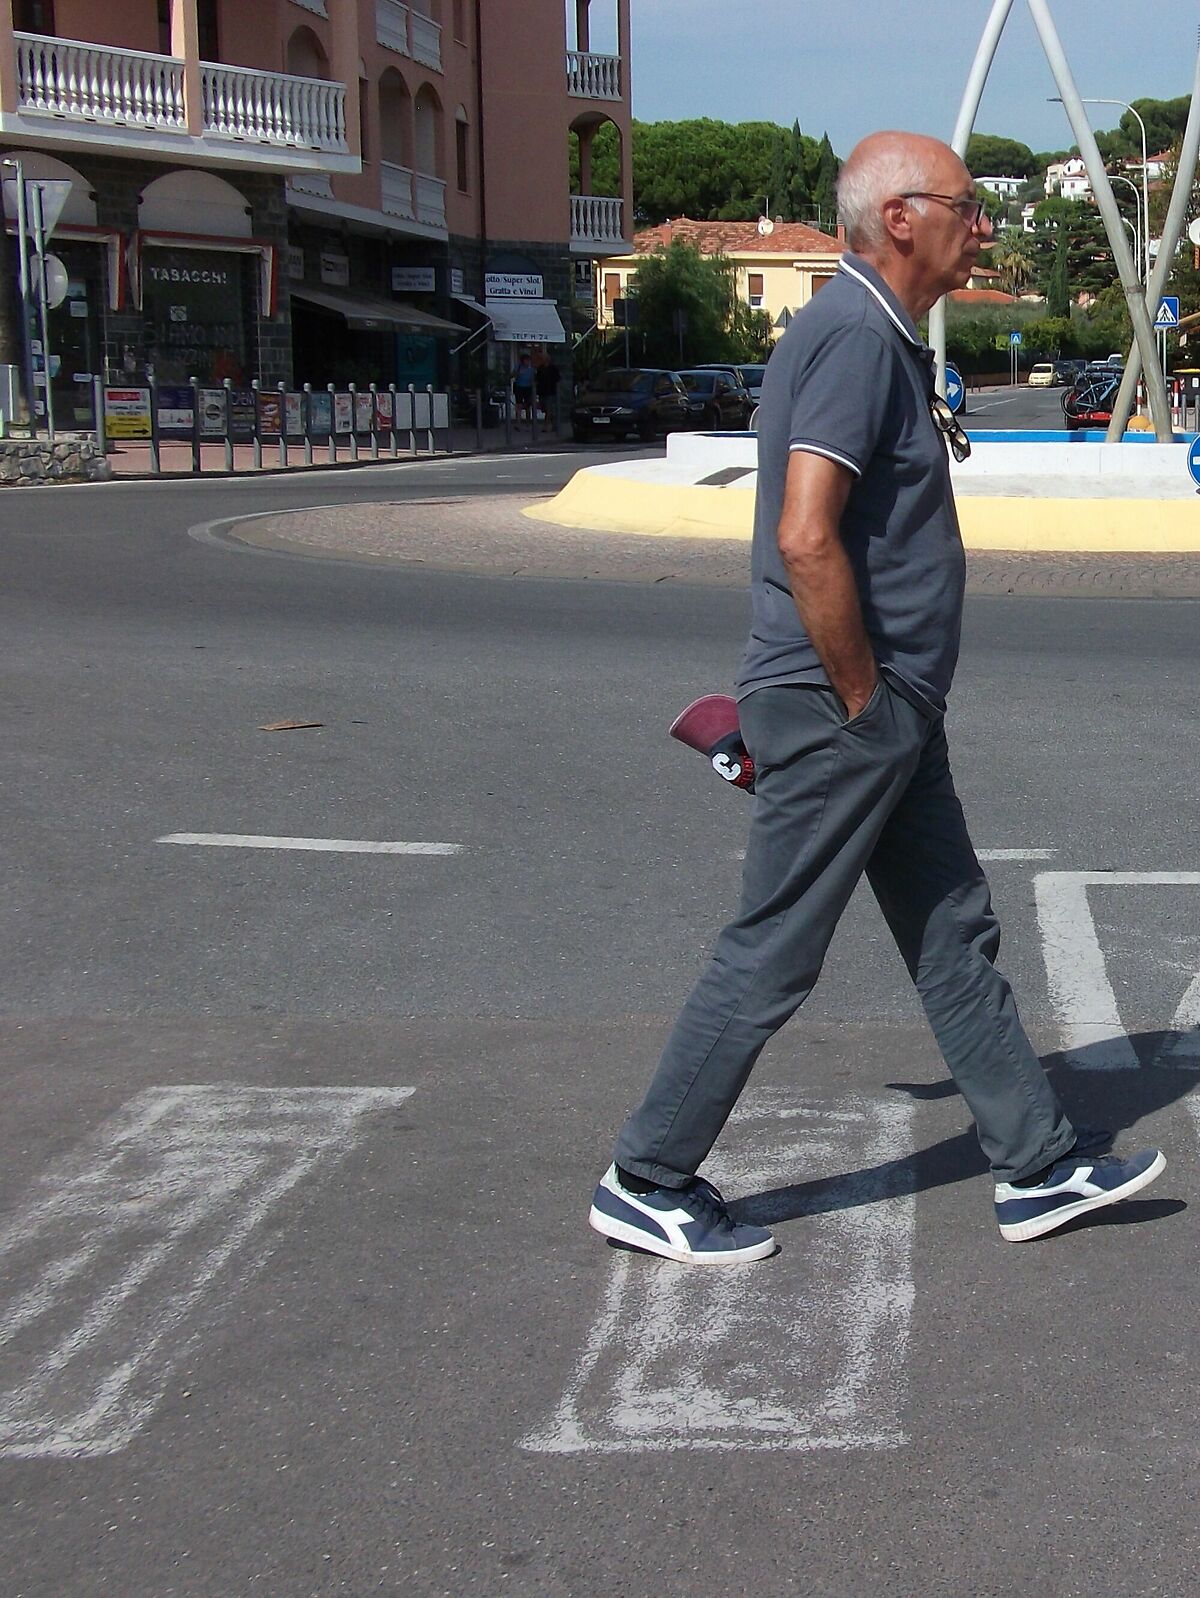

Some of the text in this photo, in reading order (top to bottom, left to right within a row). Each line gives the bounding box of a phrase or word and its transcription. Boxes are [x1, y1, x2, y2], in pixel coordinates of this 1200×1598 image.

[151, 267, 227, 285] TABACCHI
[503, 276, 523, 286] Super
[490, 287, 511, 295] Gratta
[519, 287, 537, 295] Vinci
[512, 332, 527, 340] SELF
